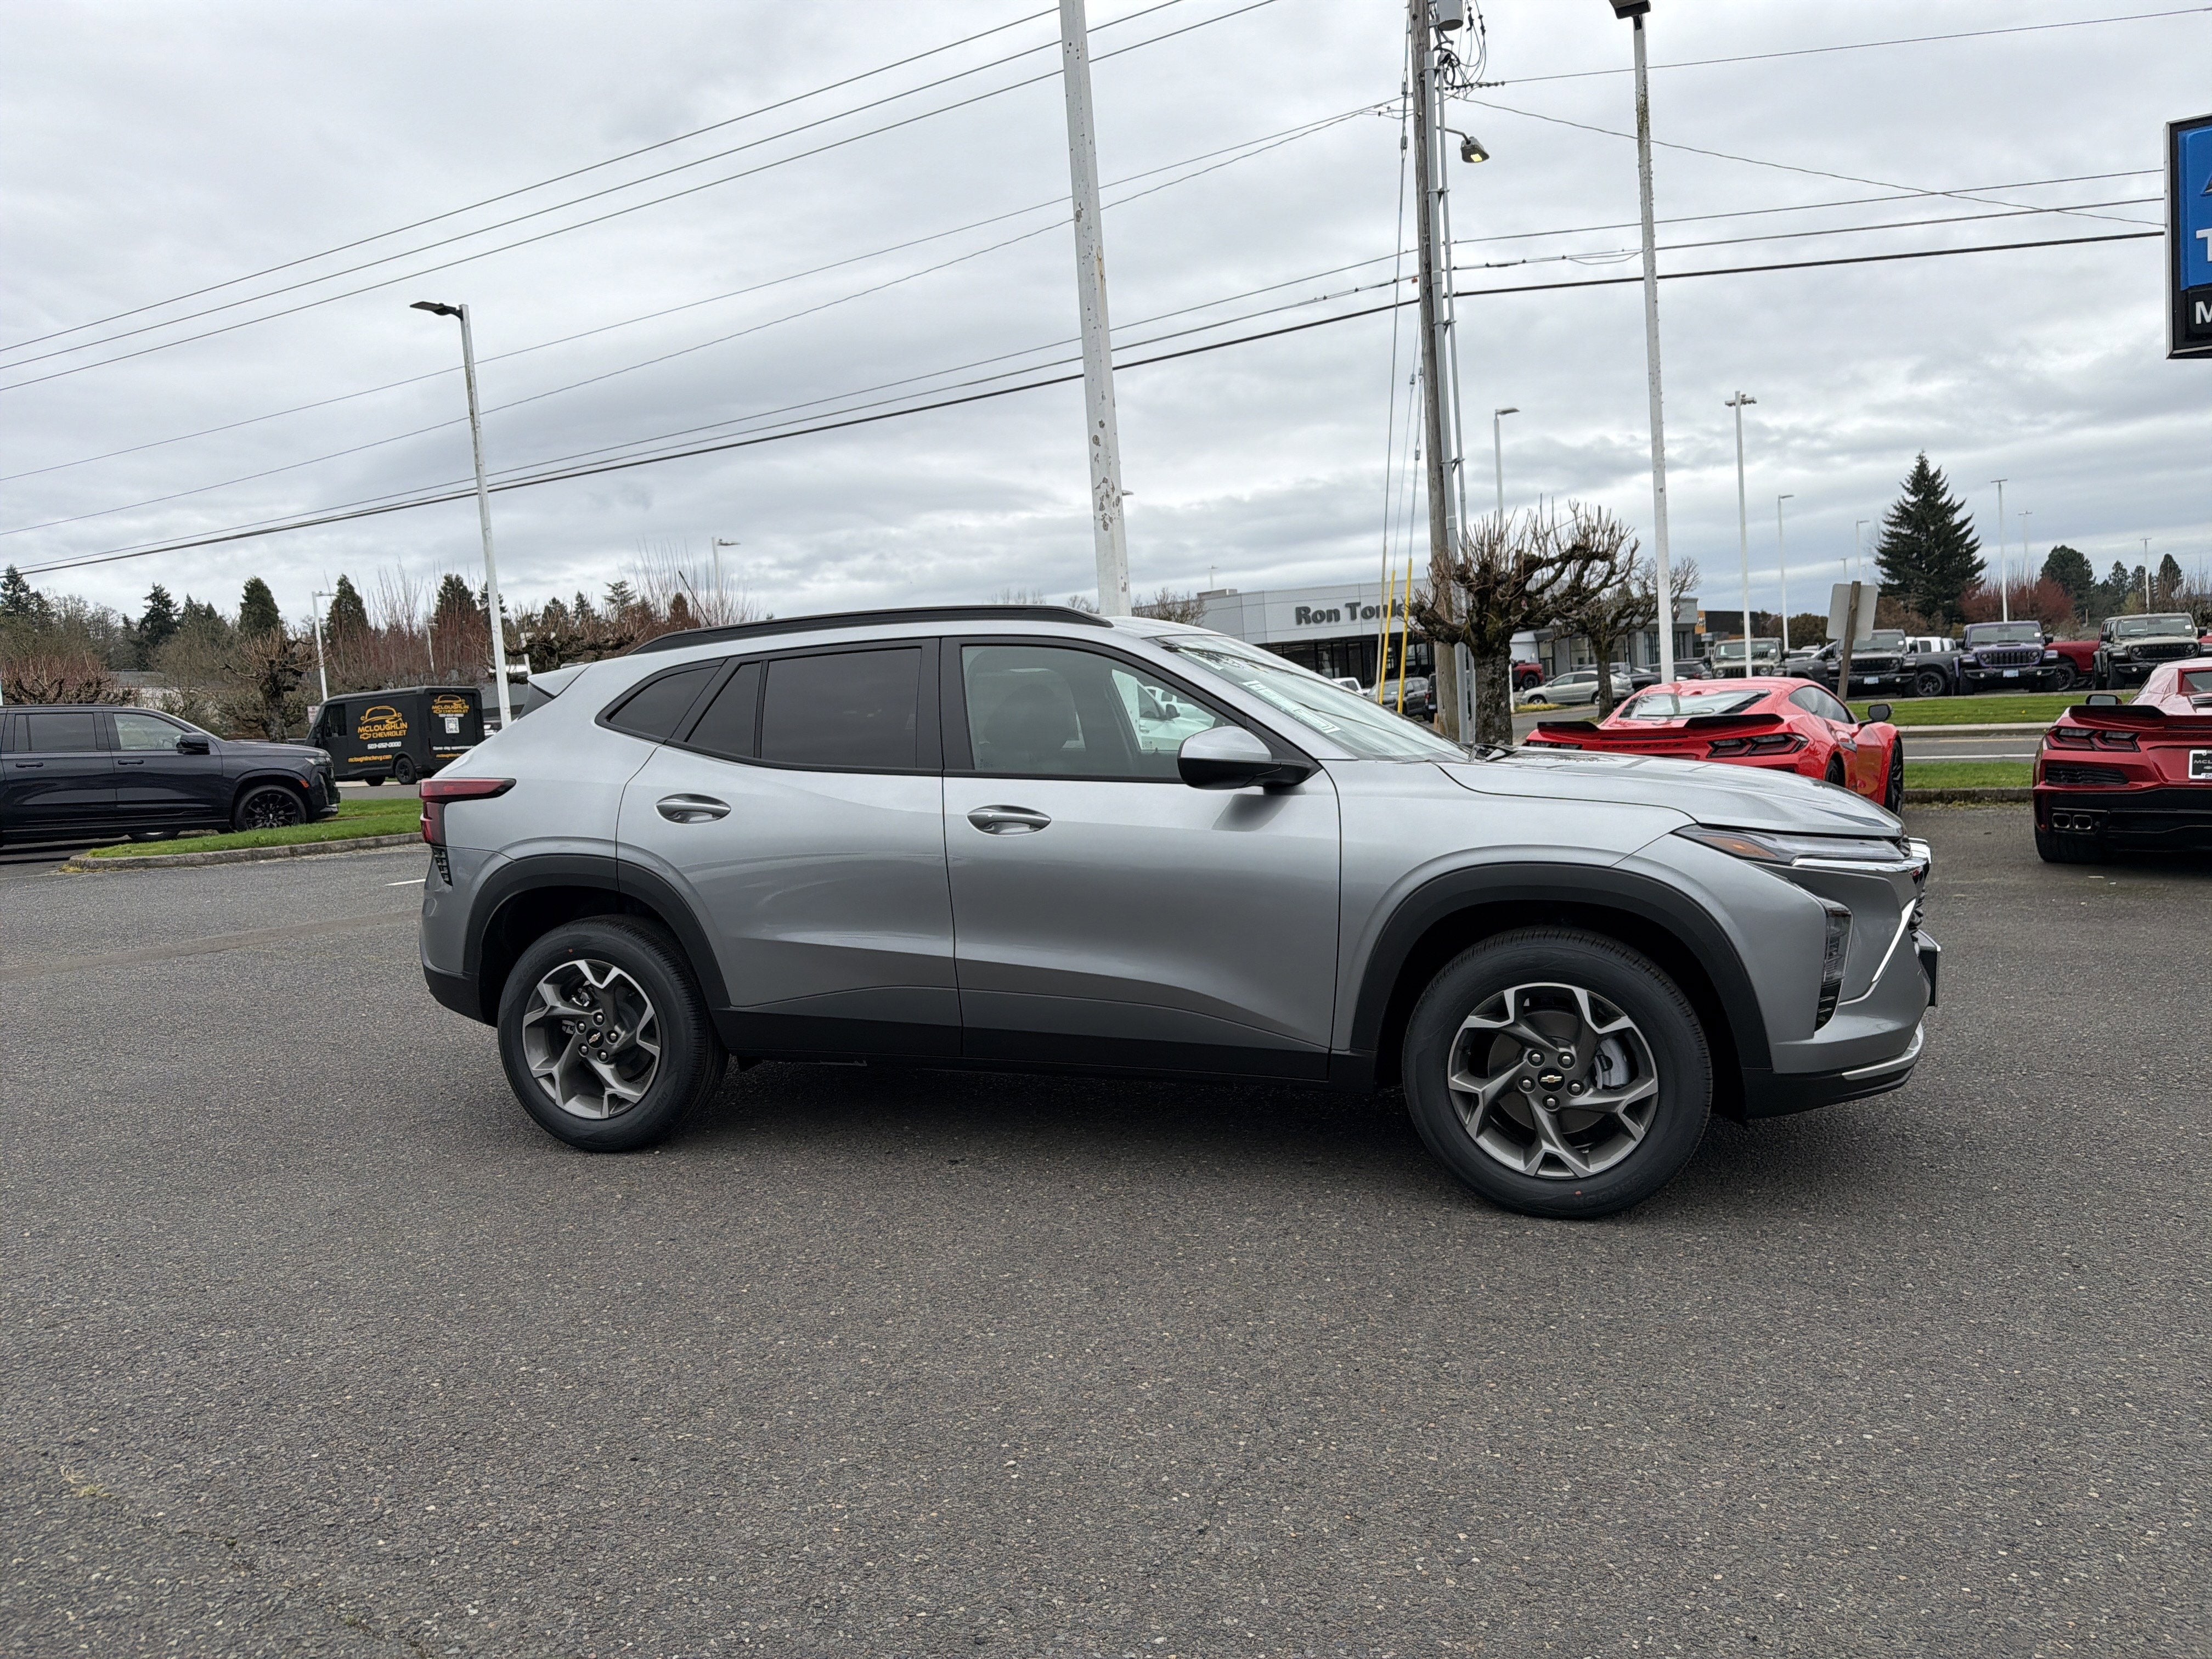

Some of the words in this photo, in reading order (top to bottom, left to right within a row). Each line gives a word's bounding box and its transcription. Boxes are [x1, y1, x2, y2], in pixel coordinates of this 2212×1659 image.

[1295, 606, 1341, 625] Ron
[357, 721, 408, 733] MCLOUGHLIN
[373, 730, 407, 738] CHEVROLET
